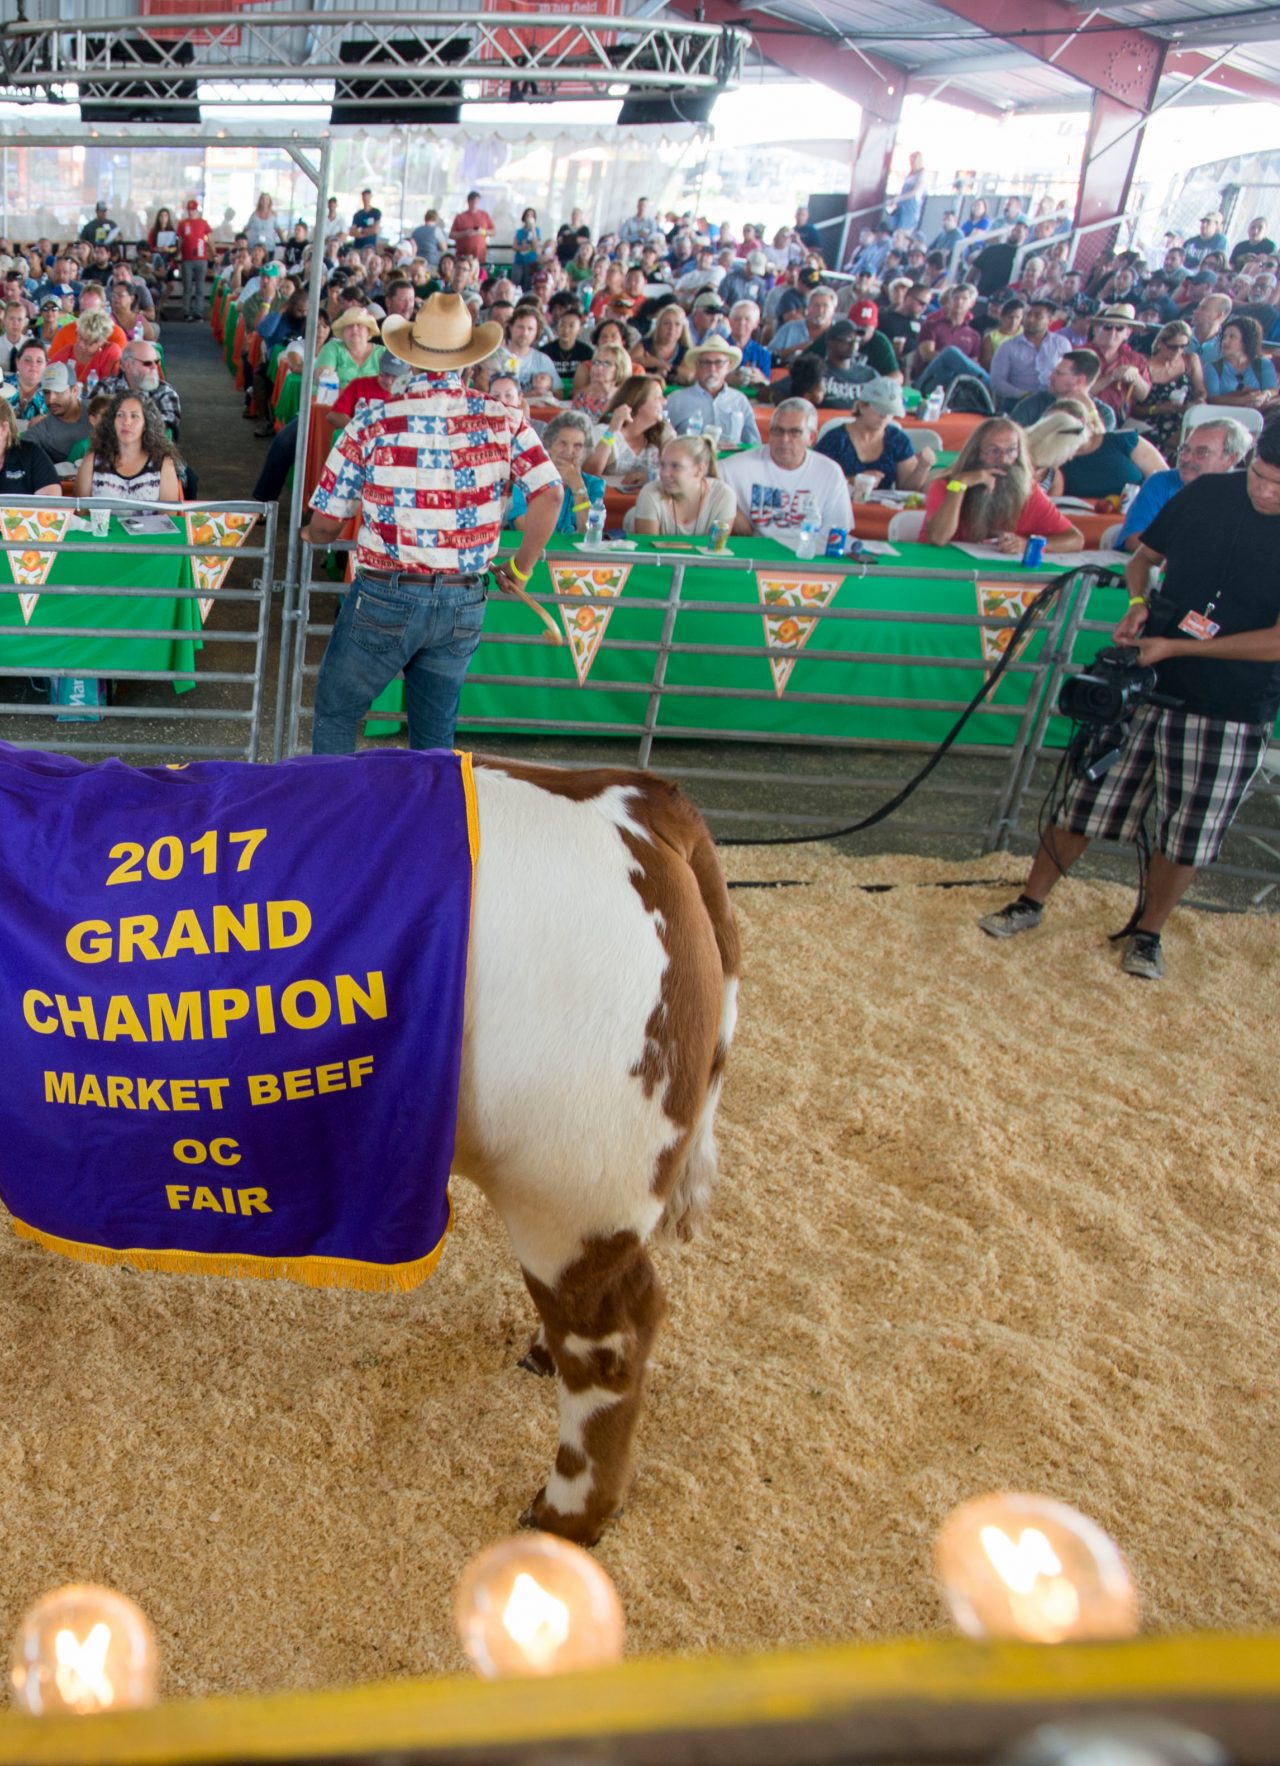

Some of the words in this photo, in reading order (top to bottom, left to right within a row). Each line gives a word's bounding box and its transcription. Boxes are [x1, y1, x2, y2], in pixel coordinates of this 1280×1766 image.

[572, 2, 597, 13] field
[105, 828, 268, 886] 2017
[65, 899, 313, 964] GRAND
[23, 970, 389, 1043] CHAMPION
[43, 1071, 230, 1111] MARKET
[248, 1055, 375, 1107] BEEF
[173, 1137, 242, 1166] OC
[165, 1185, 272, 1216] FAIR
